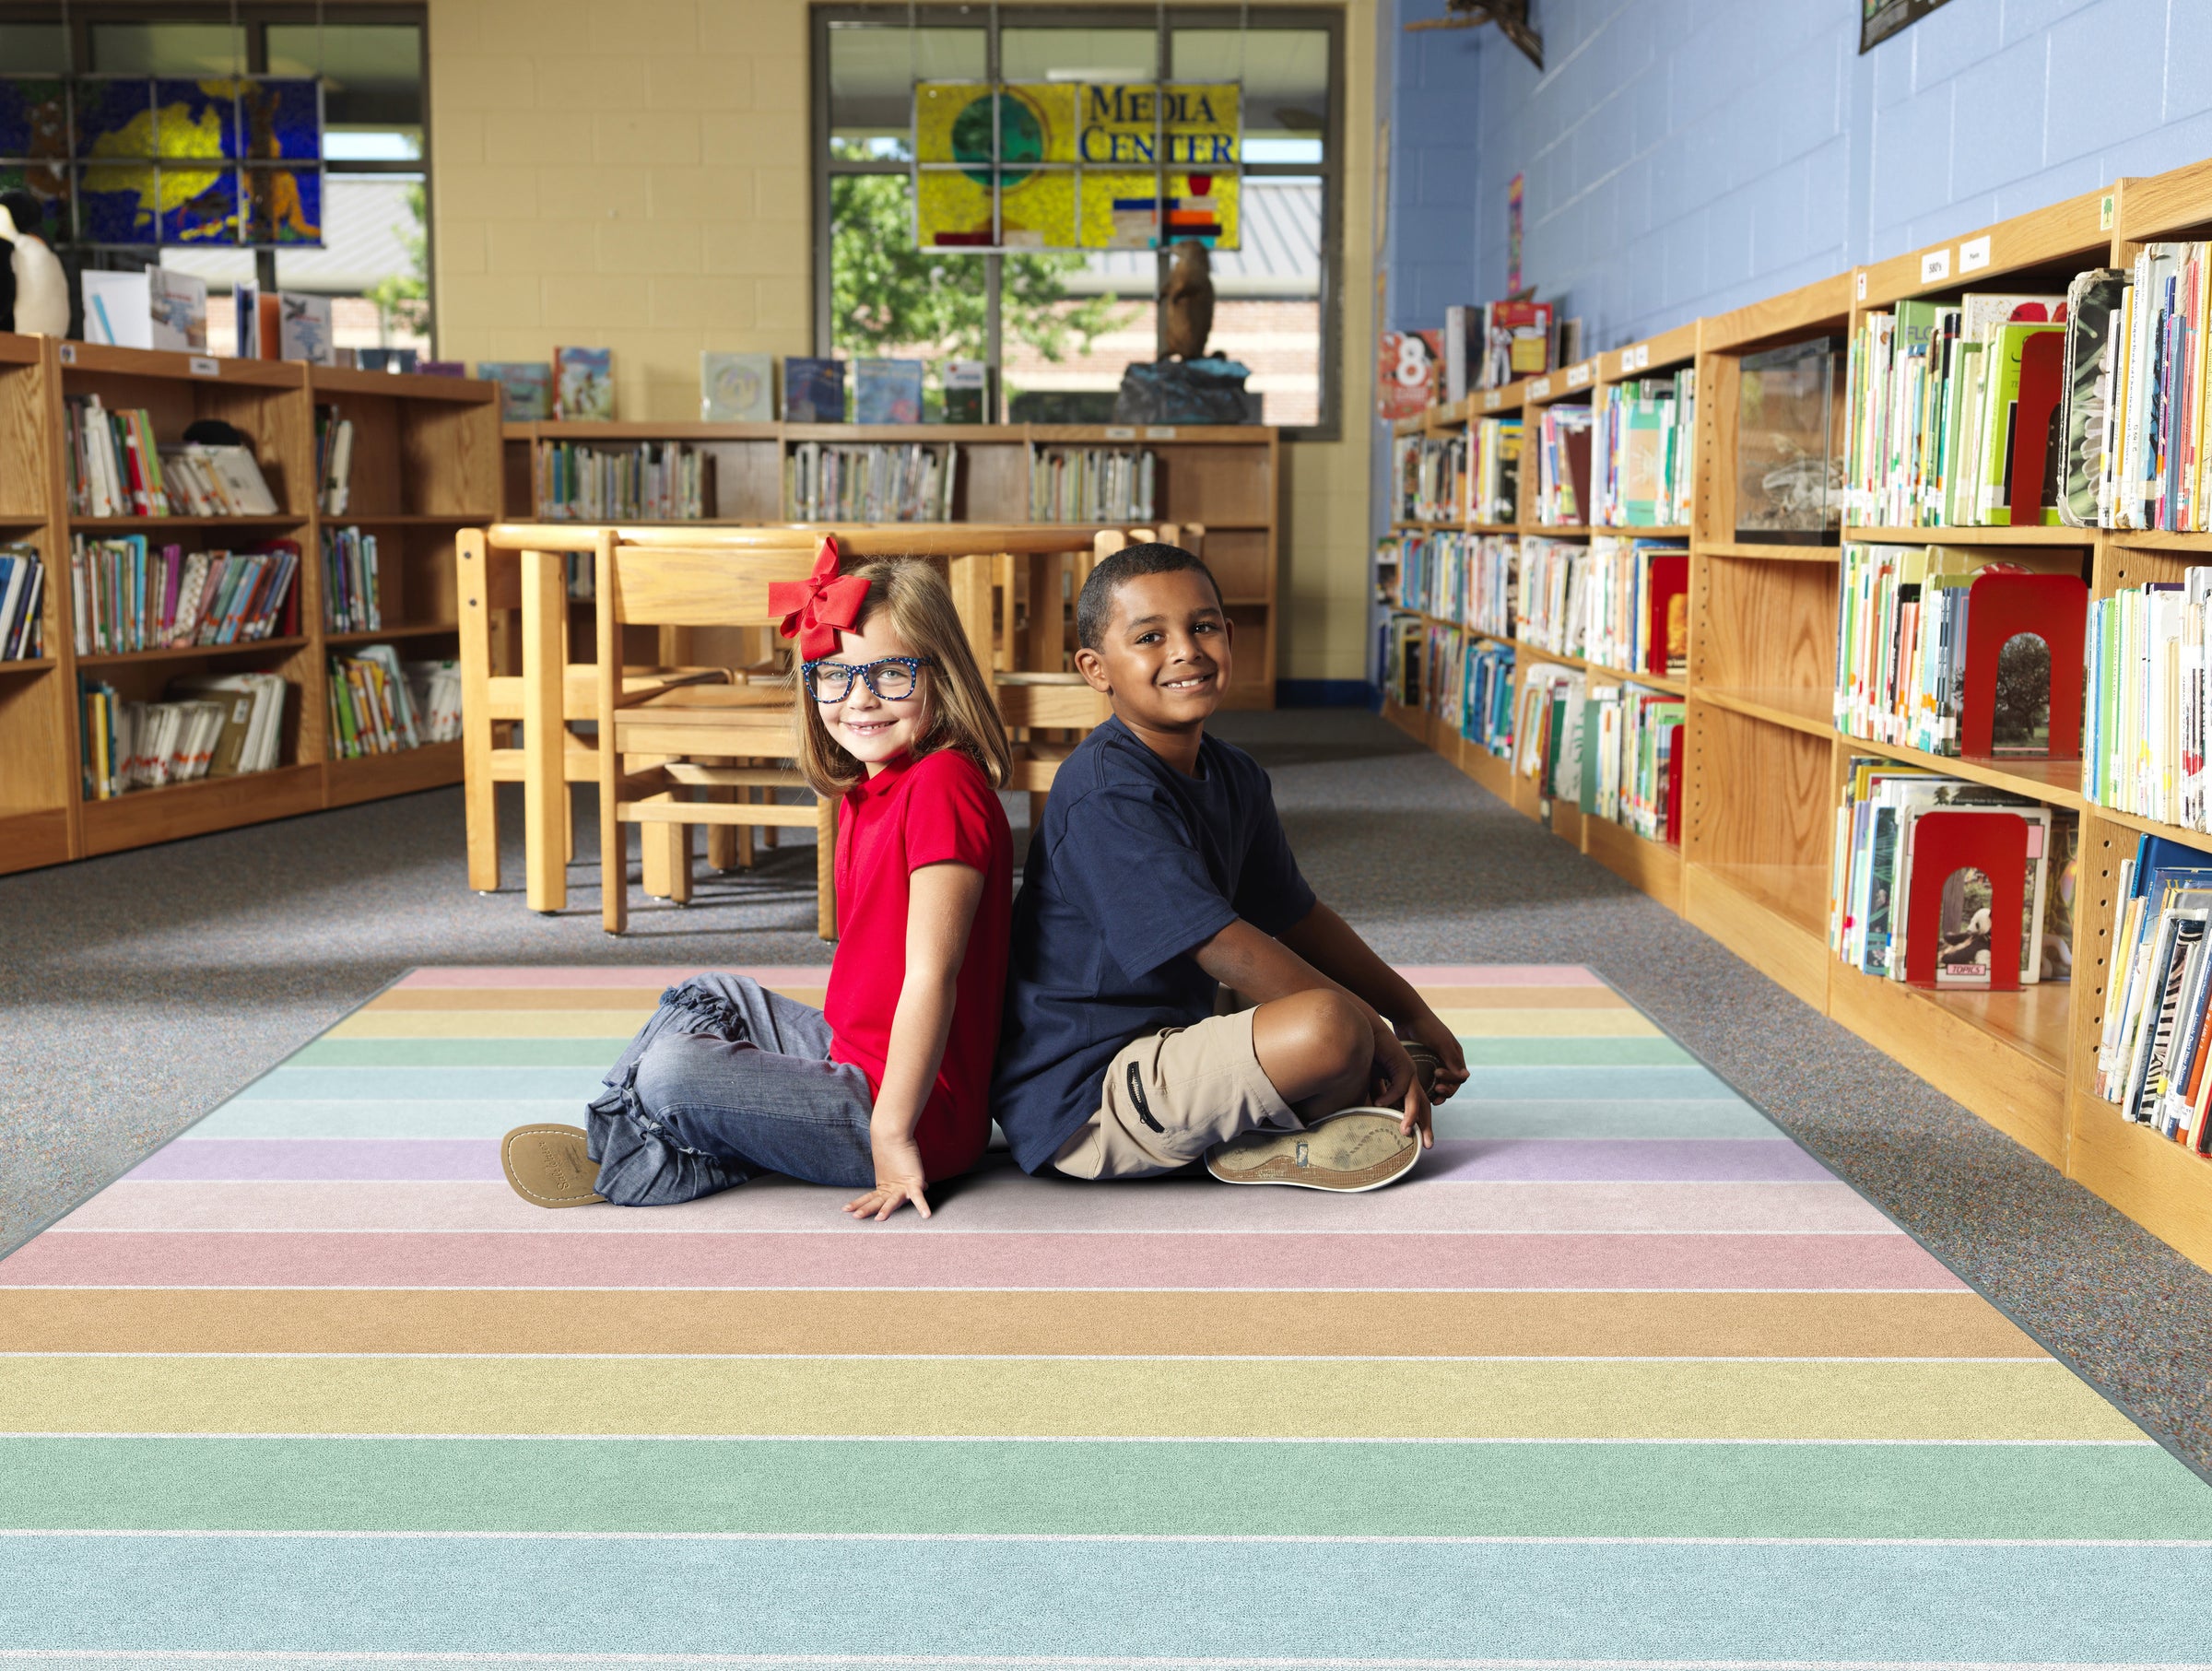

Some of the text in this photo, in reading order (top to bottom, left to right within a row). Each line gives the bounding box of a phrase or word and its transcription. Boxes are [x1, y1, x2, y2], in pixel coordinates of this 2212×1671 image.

[1089, 86, 1218, 124] MEDIA
[1079, 125, 1234, 163] CENTER
[1396, 336, 1427, 386] 8
[1953, 965, 1981, 973] TOPICS
